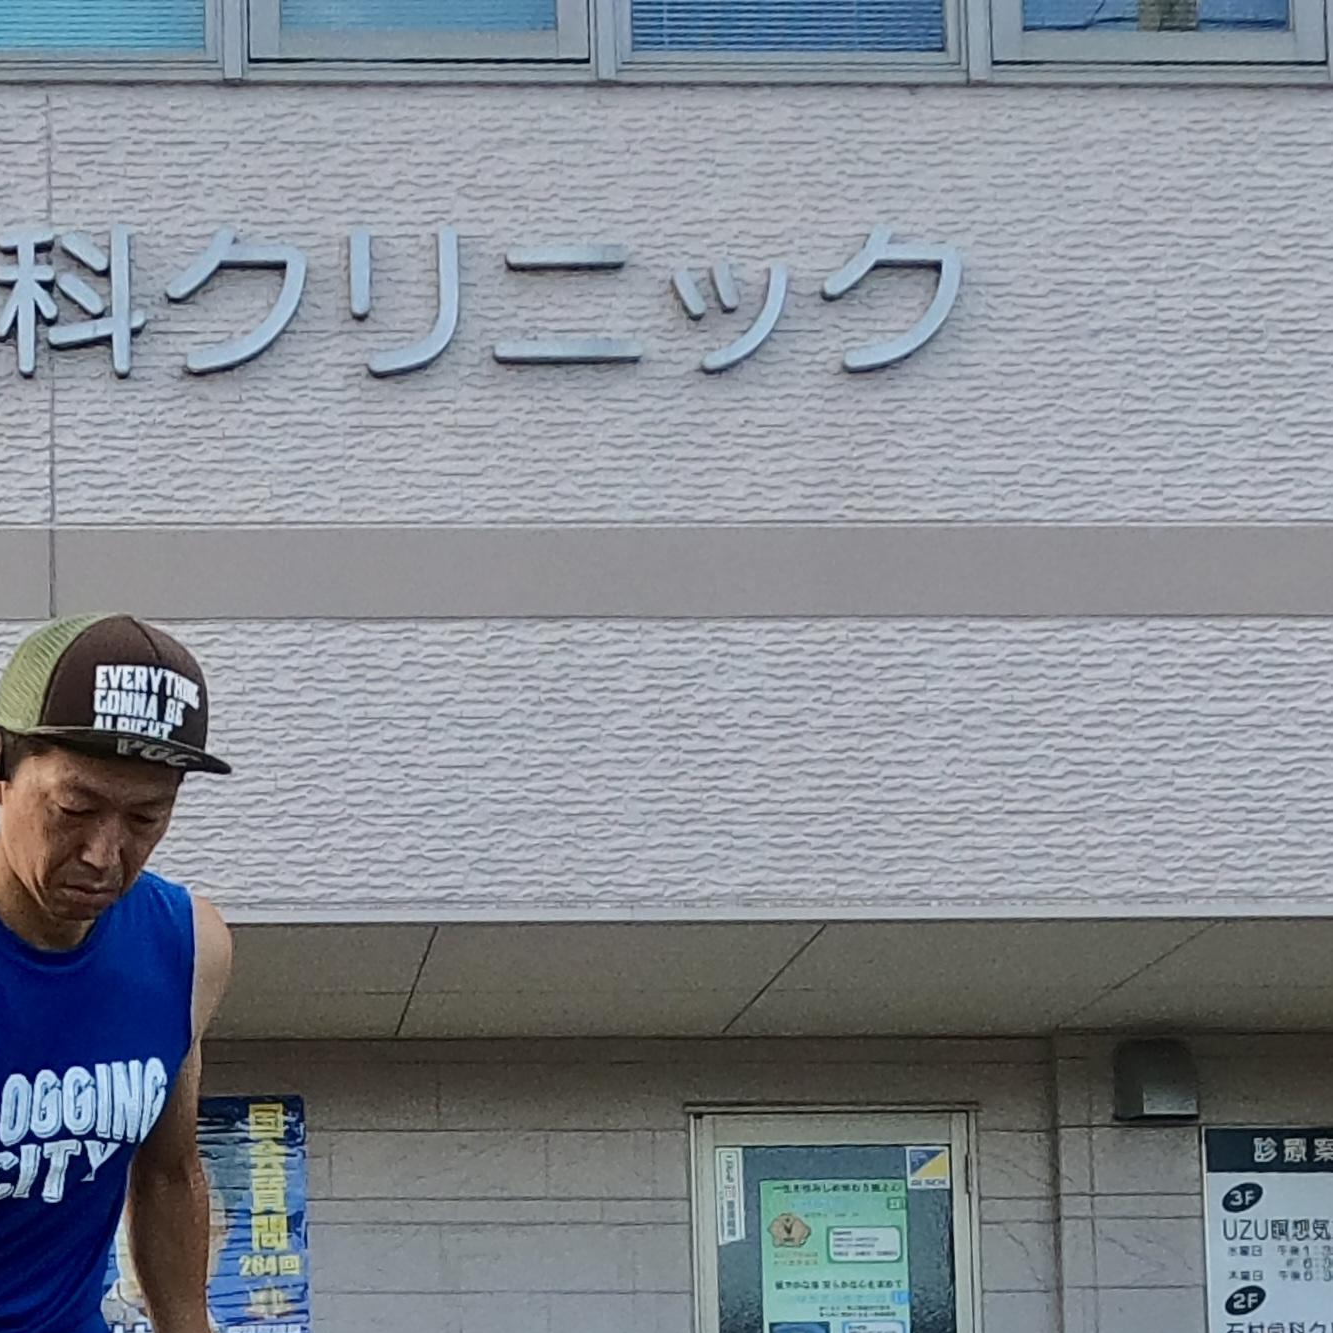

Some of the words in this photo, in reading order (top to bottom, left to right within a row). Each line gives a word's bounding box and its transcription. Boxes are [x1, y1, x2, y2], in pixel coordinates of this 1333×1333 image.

[93, 689, 158, 721] GONNA
[164, 698, 185, 727] BE
[1229, 1189, 1256, 1206] 3F
[1223, 1219, 1333, 1241] UZU瞑想気
[1232, 1293, 1259, 1309] 2F
